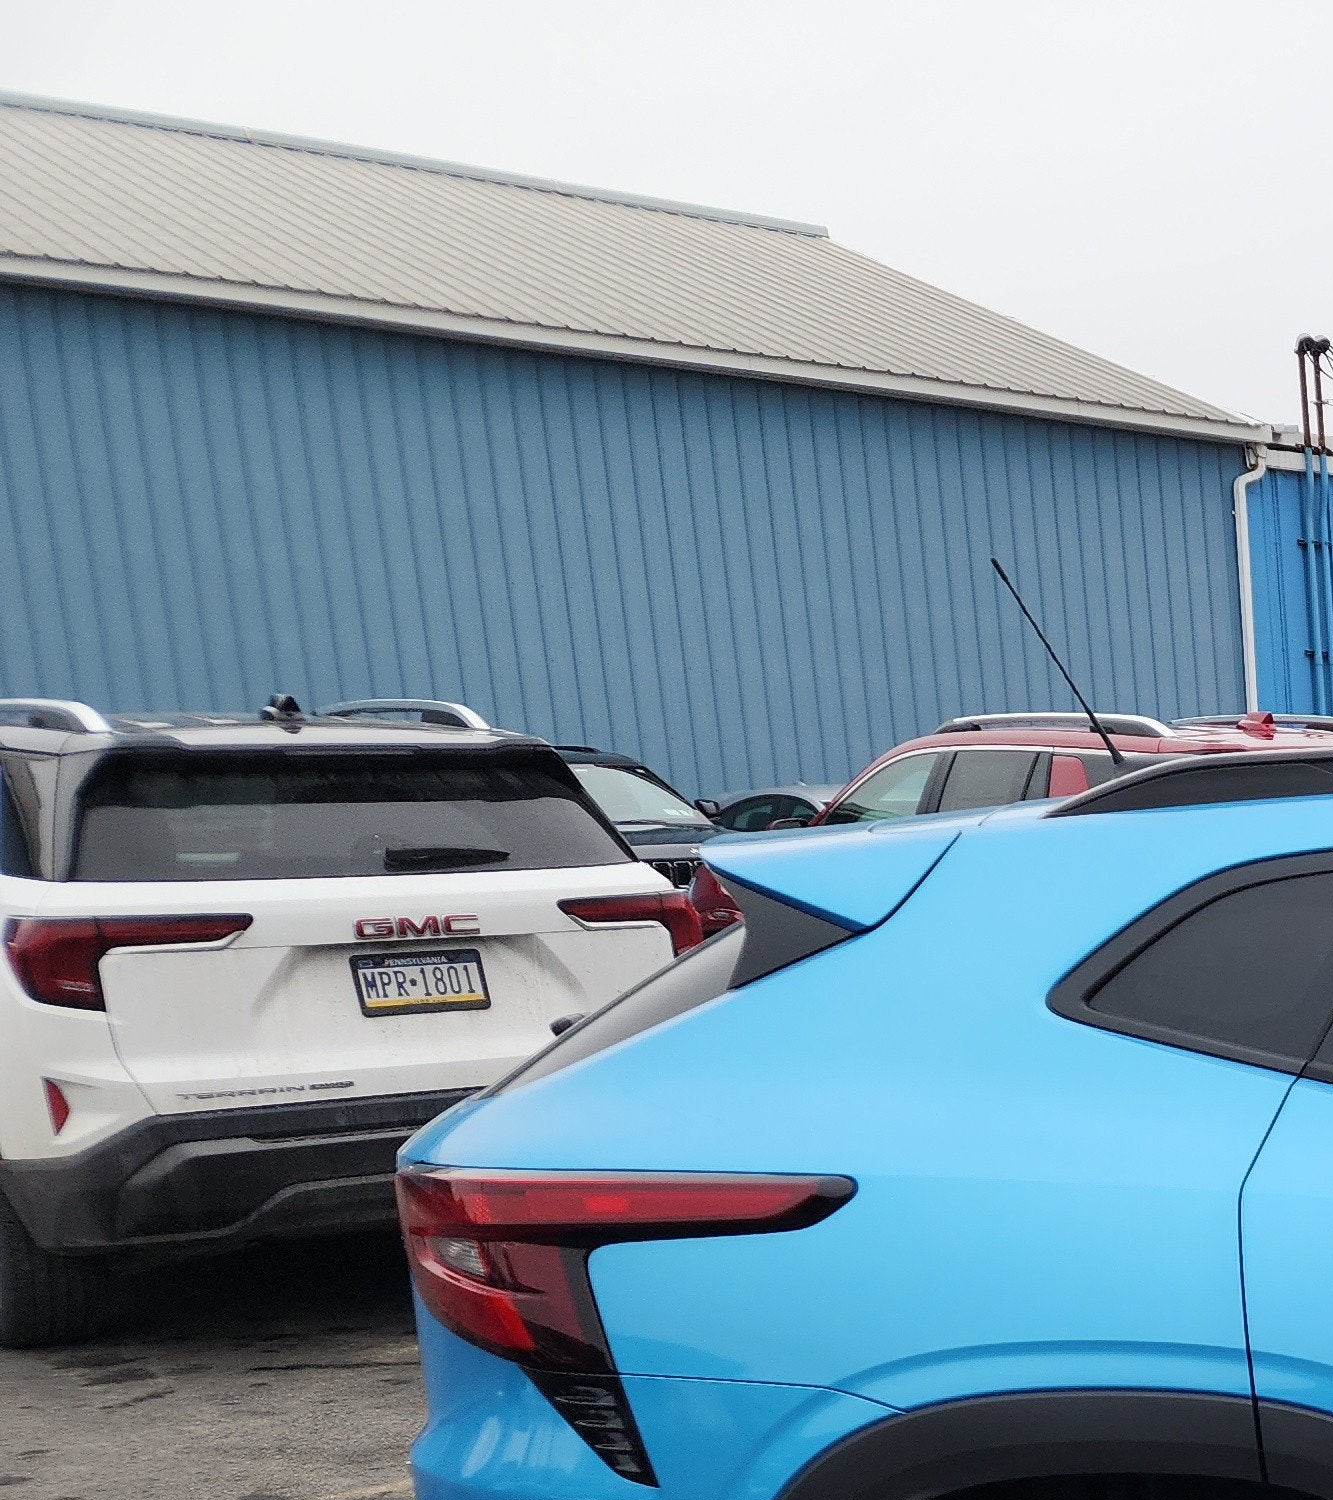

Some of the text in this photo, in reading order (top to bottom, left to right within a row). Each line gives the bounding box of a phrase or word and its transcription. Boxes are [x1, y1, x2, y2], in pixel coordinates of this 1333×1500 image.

[354, 913, 480, 940] GMC
[384, 956, 447, 967] PENNSYLVANIA
[177, 1085, 305, 1099] TERRAIN
